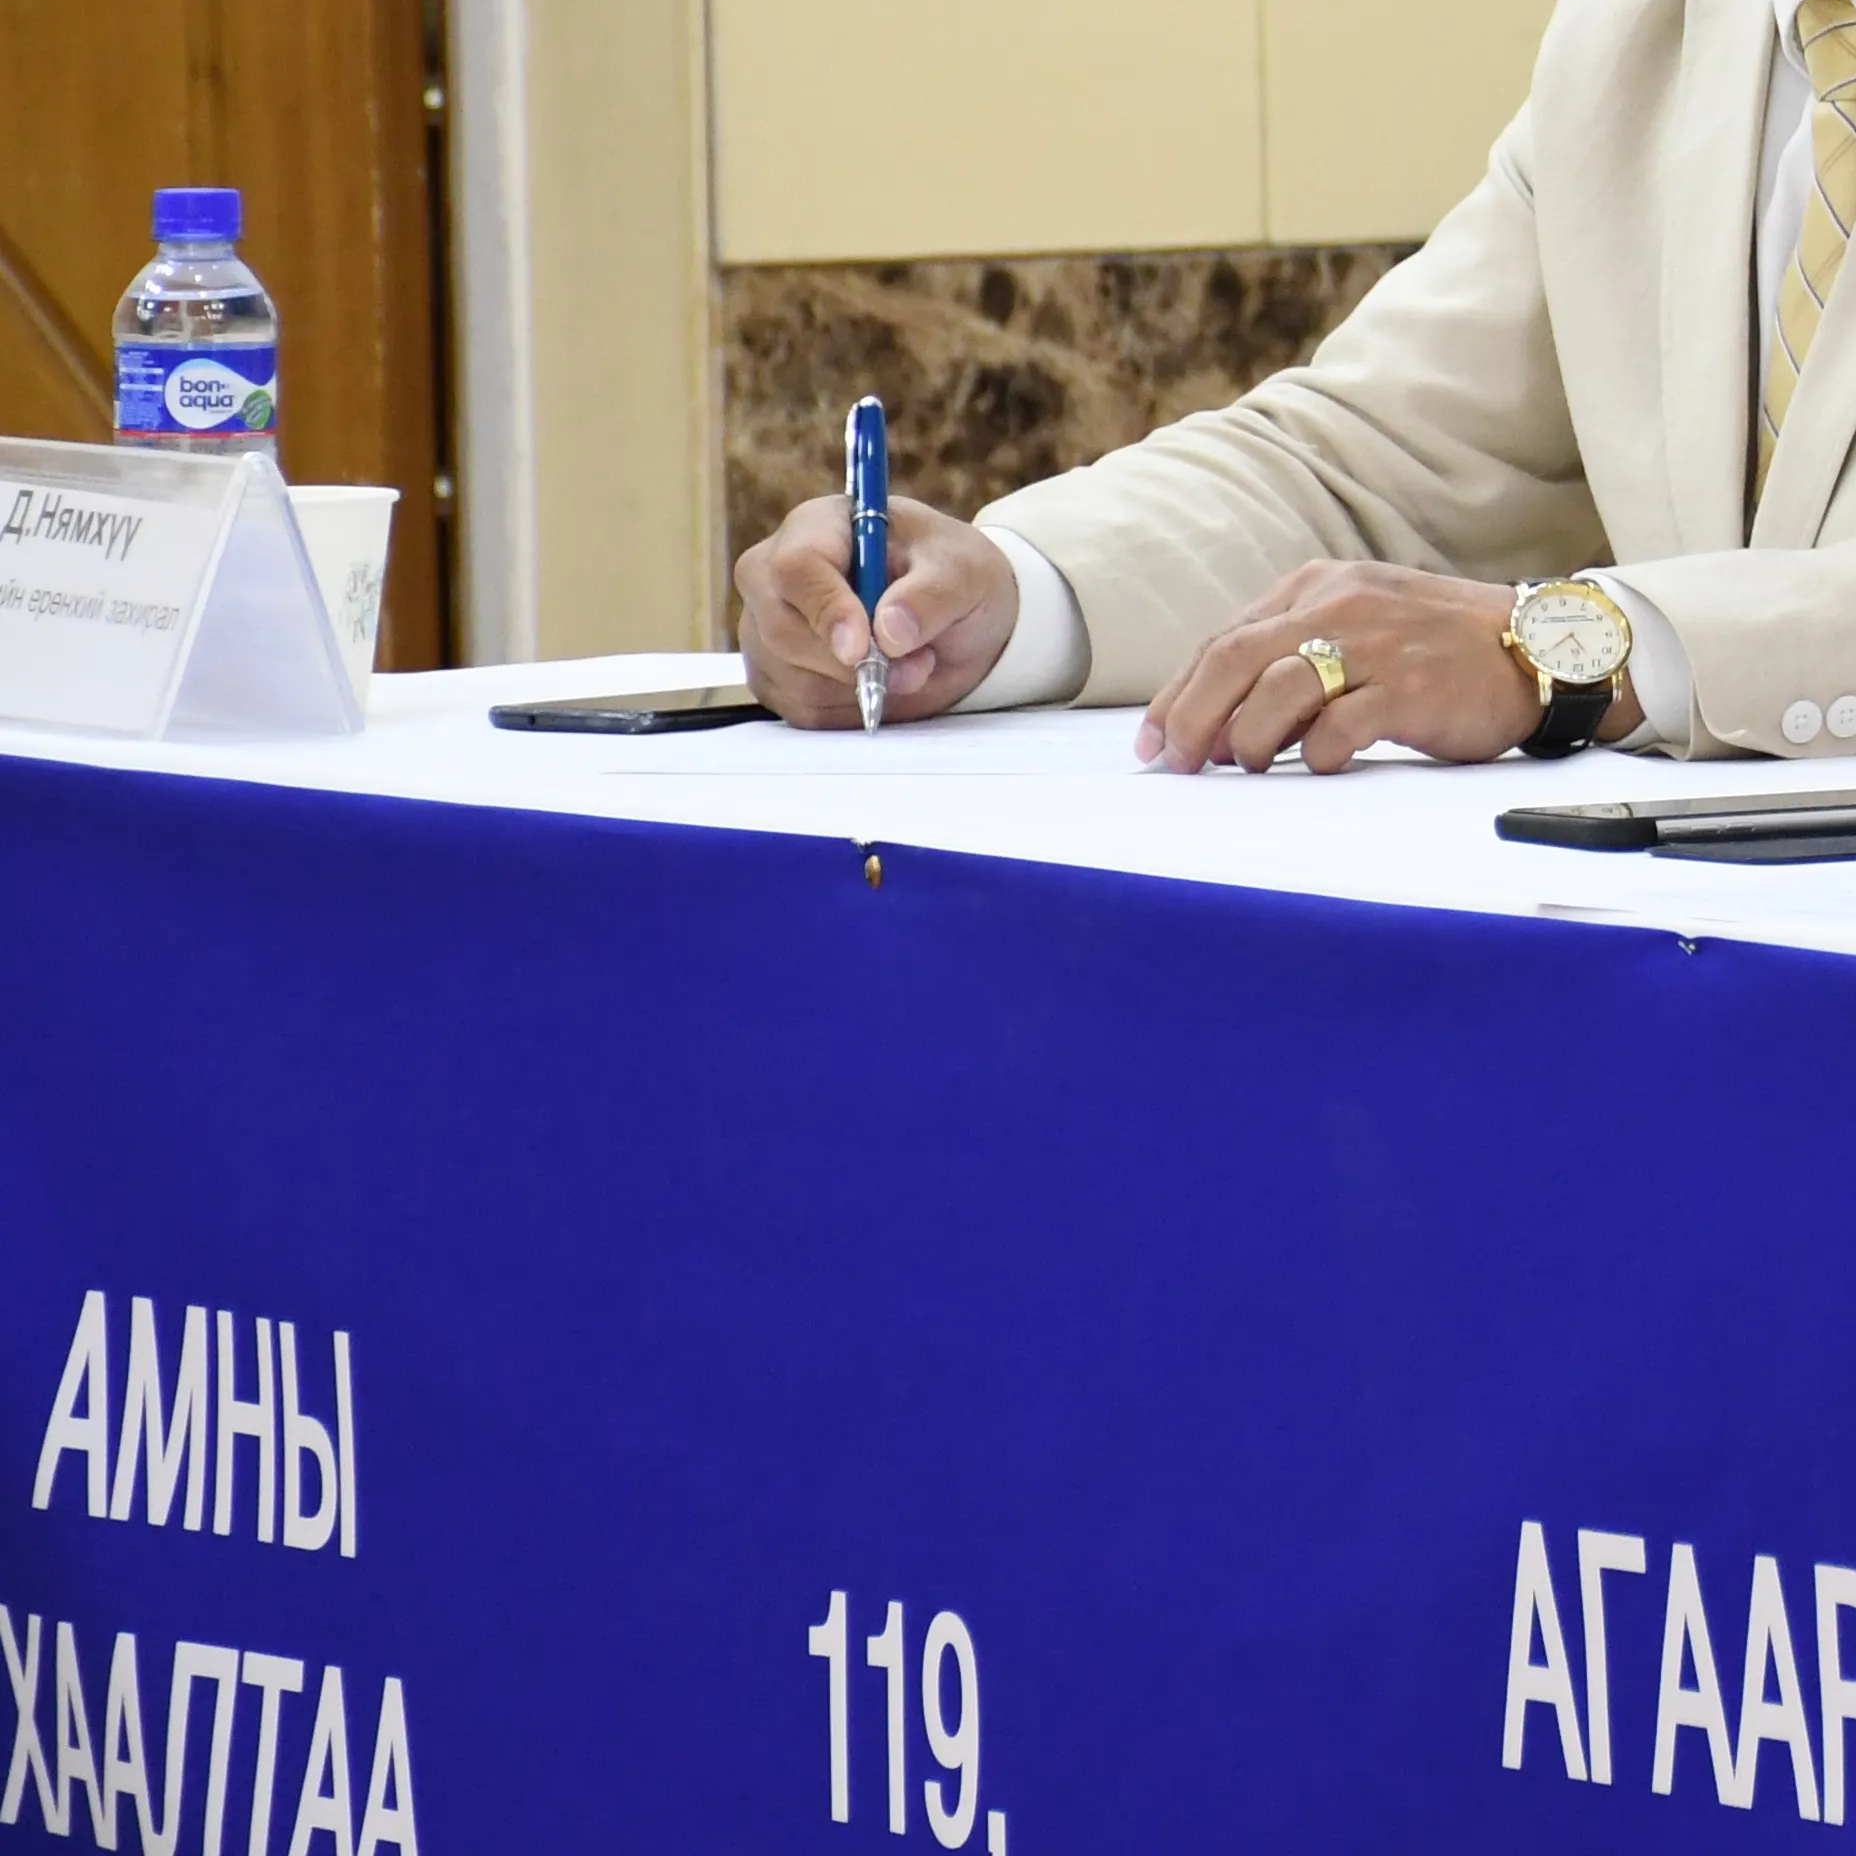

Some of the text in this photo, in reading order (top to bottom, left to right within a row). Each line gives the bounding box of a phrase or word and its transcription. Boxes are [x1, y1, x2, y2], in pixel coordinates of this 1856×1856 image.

[179, 395, 235, 411] aqua
[31, 1288, 356, 1559] АМНЫ
[0, 1603, 419, 1856] ХААЛТАА
